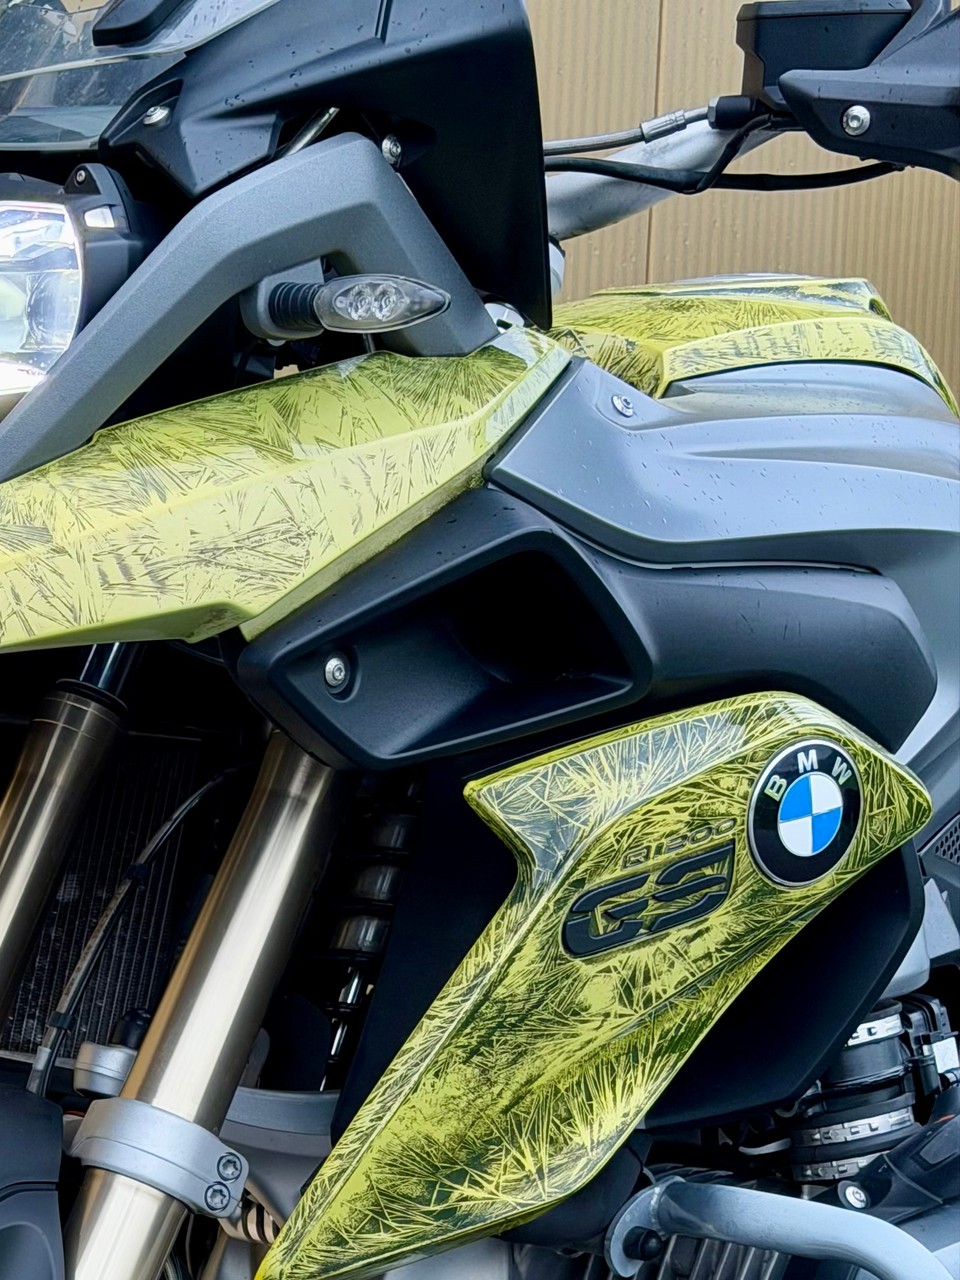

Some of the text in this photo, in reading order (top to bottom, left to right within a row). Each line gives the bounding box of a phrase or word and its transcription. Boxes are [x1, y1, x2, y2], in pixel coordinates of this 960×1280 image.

[765, 748, 851, 802] BMW
[620, 817, 738, 871] R1200
[563, 839, 737, 956] GS
